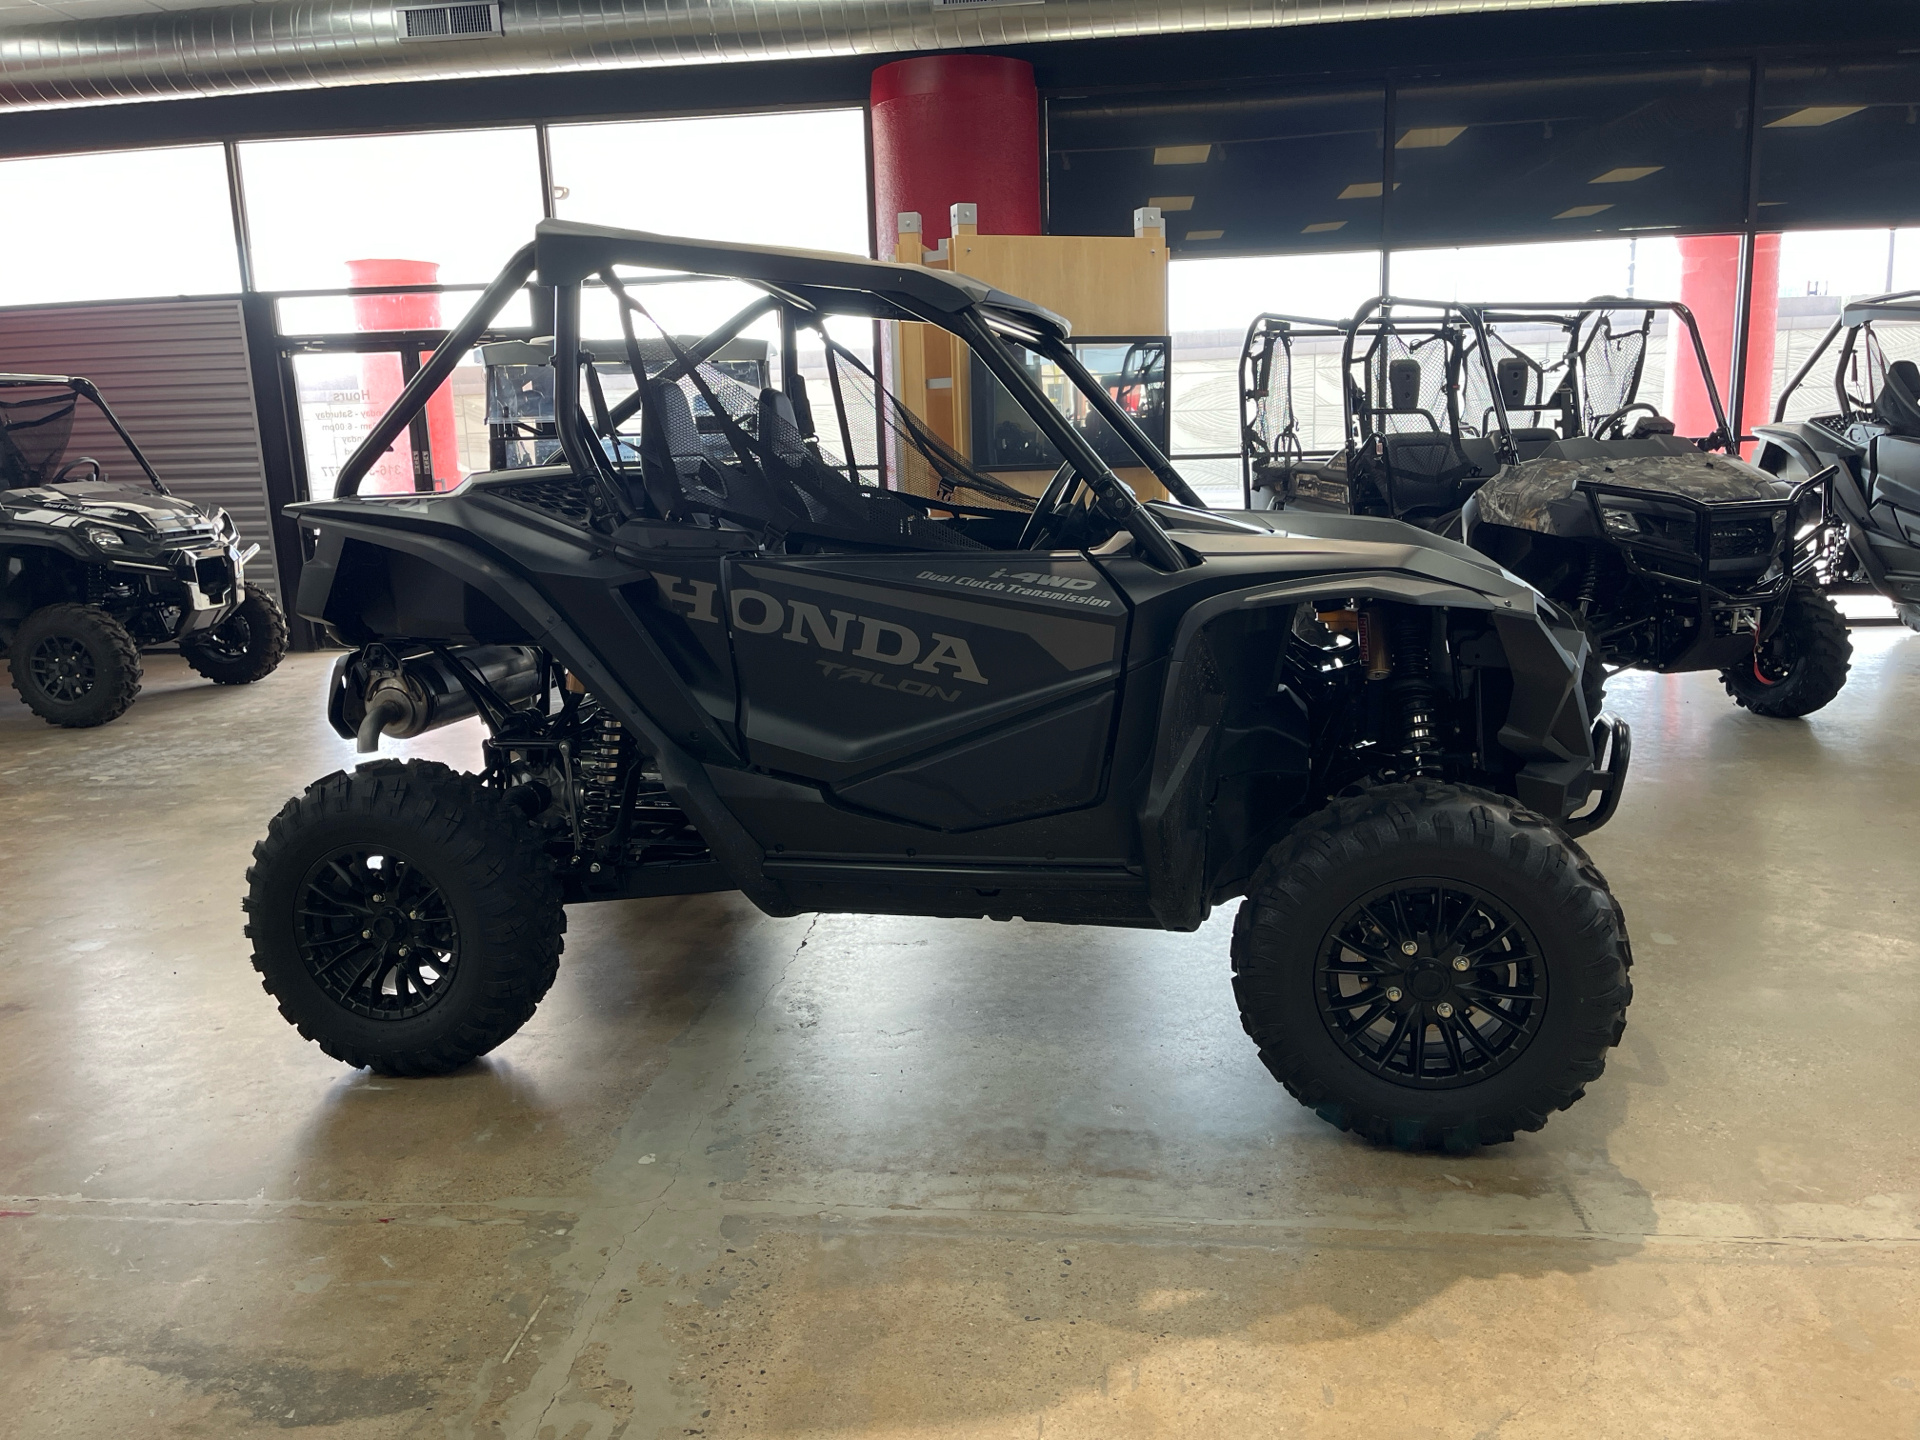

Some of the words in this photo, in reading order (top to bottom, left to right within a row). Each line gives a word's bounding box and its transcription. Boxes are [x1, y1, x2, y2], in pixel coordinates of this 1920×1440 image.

[915, 570, 957, 584] Dual
[956, 576, 1006, 592] Clutch
[1006, 583, 1112, 608] Transmission
[989, 567, 1097, 591] i-4WD
[650, 571, 989, 686] HONDA
[1358, 617, 1370, 662] SHOWA
[814, 658, 964, 704] TALON
